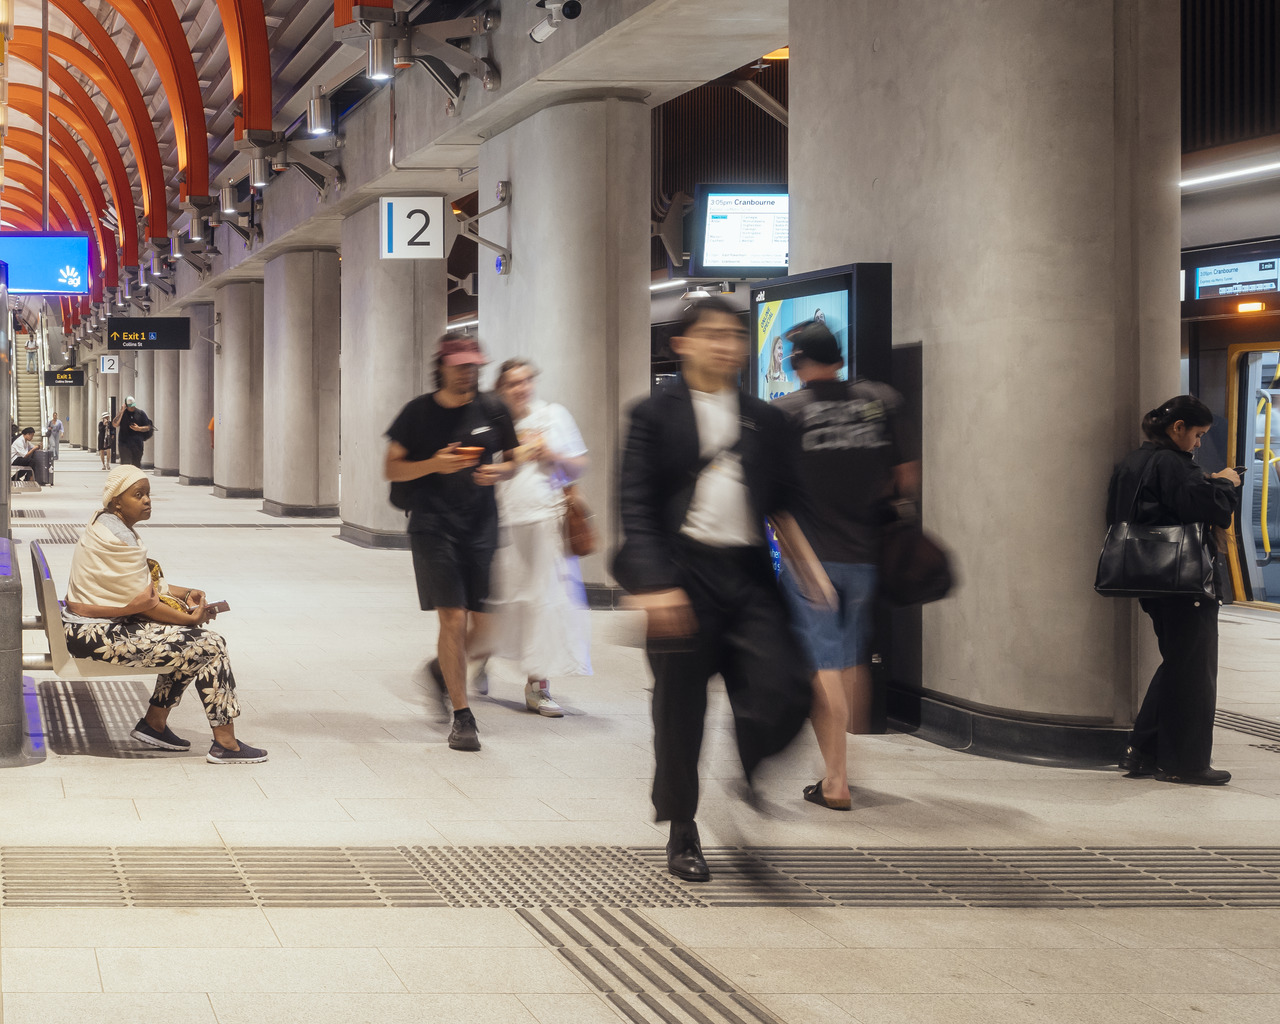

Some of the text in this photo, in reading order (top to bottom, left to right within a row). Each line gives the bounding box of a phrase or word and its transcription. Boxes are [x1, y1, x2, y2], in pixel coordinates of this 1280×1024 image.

[734, 198, 776, 206] Cranbourne
[406, 208, 431, 247] 2
[1213, 267, 1239, 275] Cranbourne
[67, 276, 81, 287] agl
[122, 332, 146, 341] Exit 1
[107, 358, 115, 370] 2
